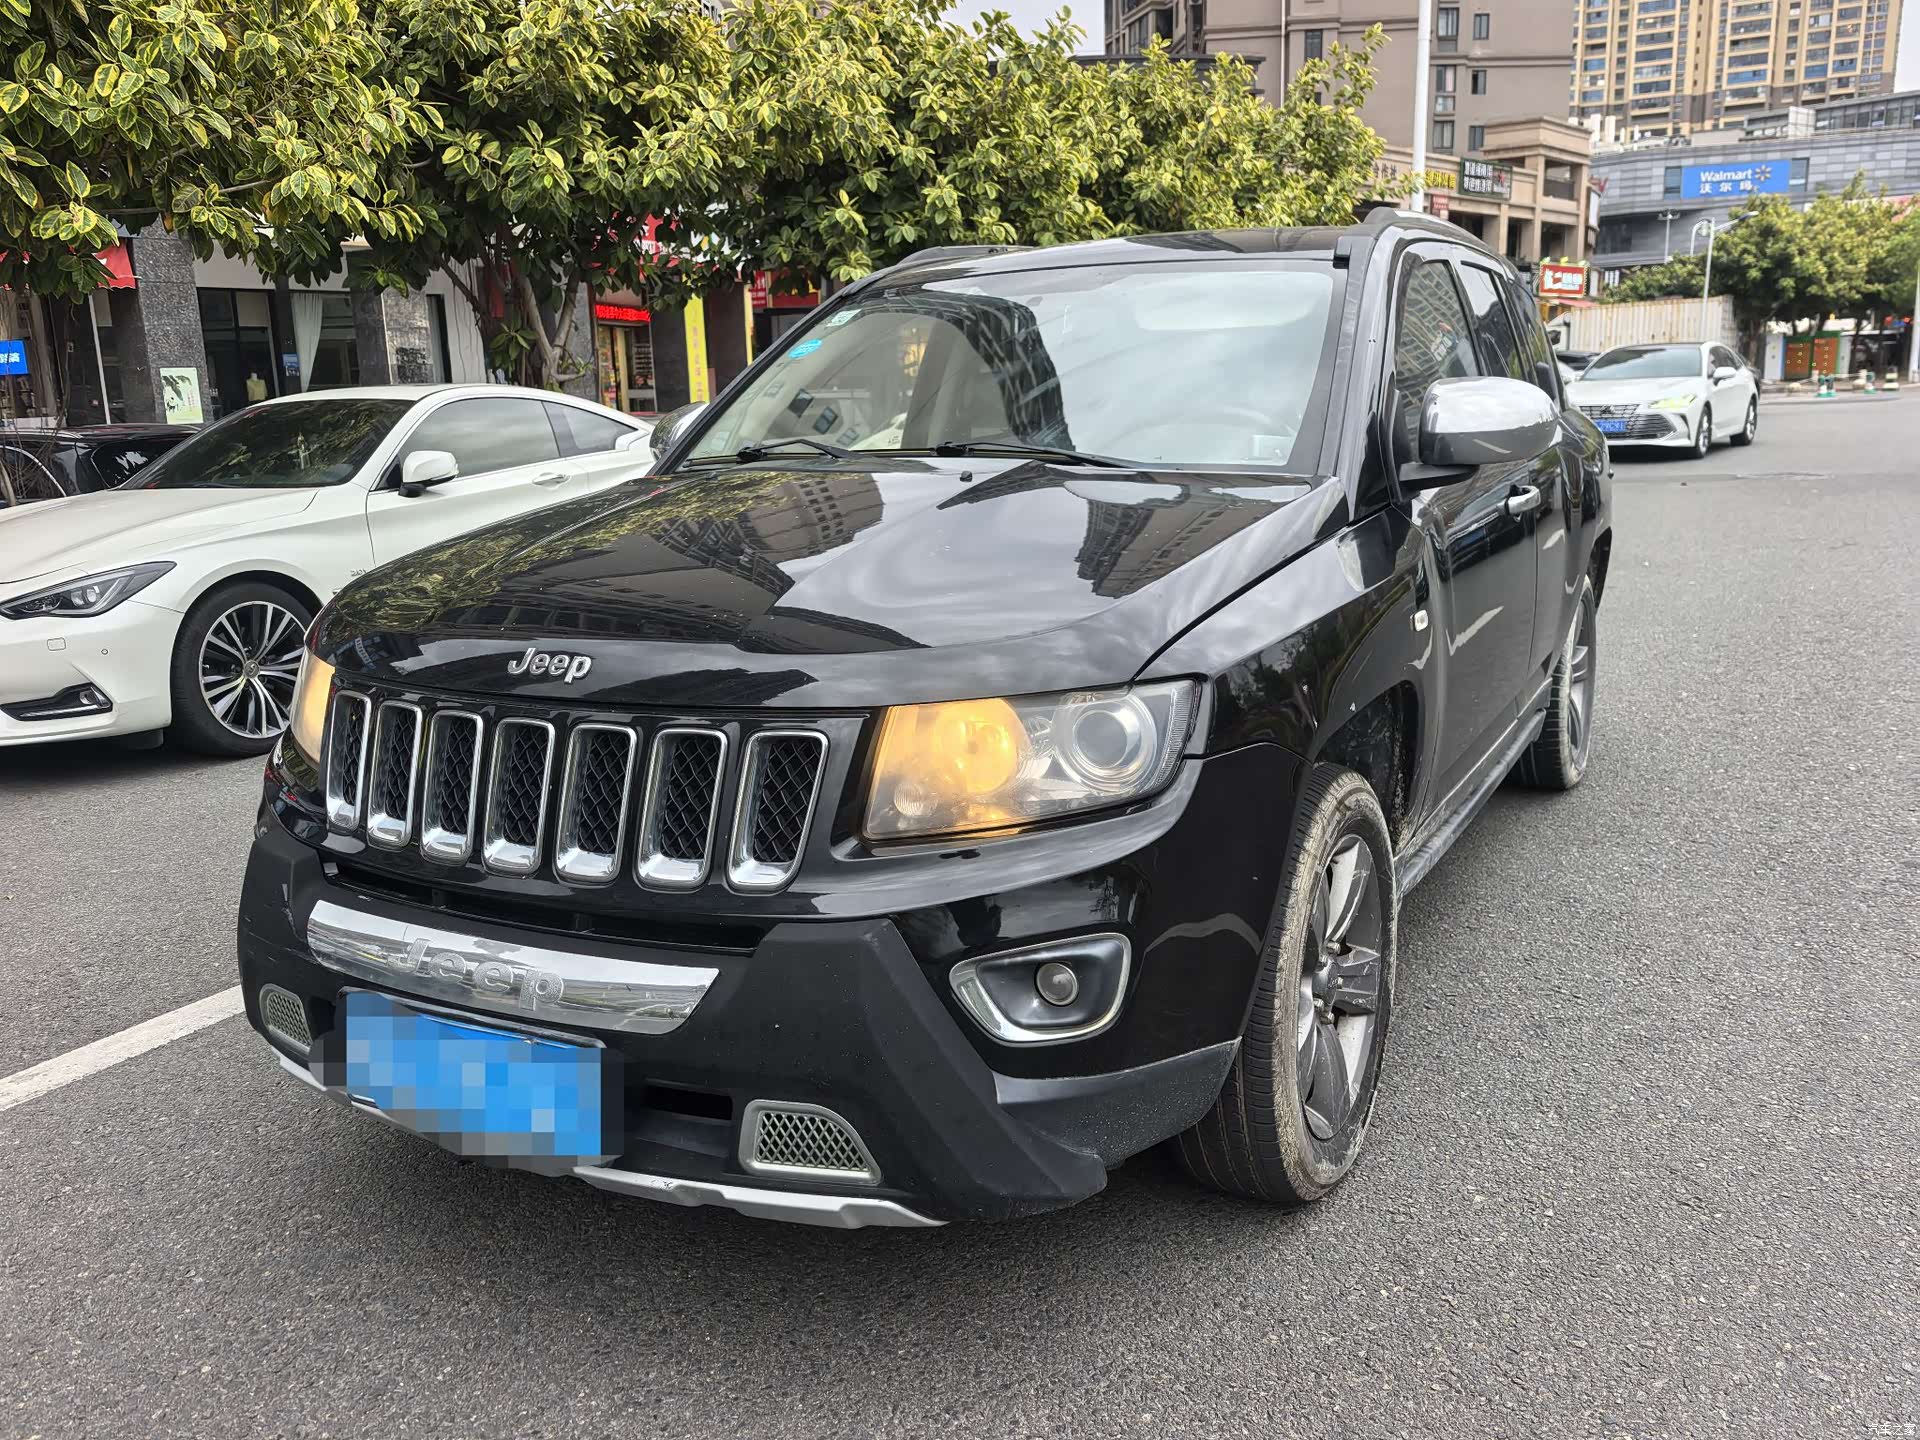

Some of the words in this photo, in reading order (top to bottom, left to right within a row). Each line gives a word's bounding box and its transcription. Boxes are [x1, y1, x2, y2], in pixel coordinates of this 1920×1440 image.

[1700, 168, 1752, 182] Walmart
[507, 647, 592, 684] Jeep
[387, 938, 564, 1011] Jeep
